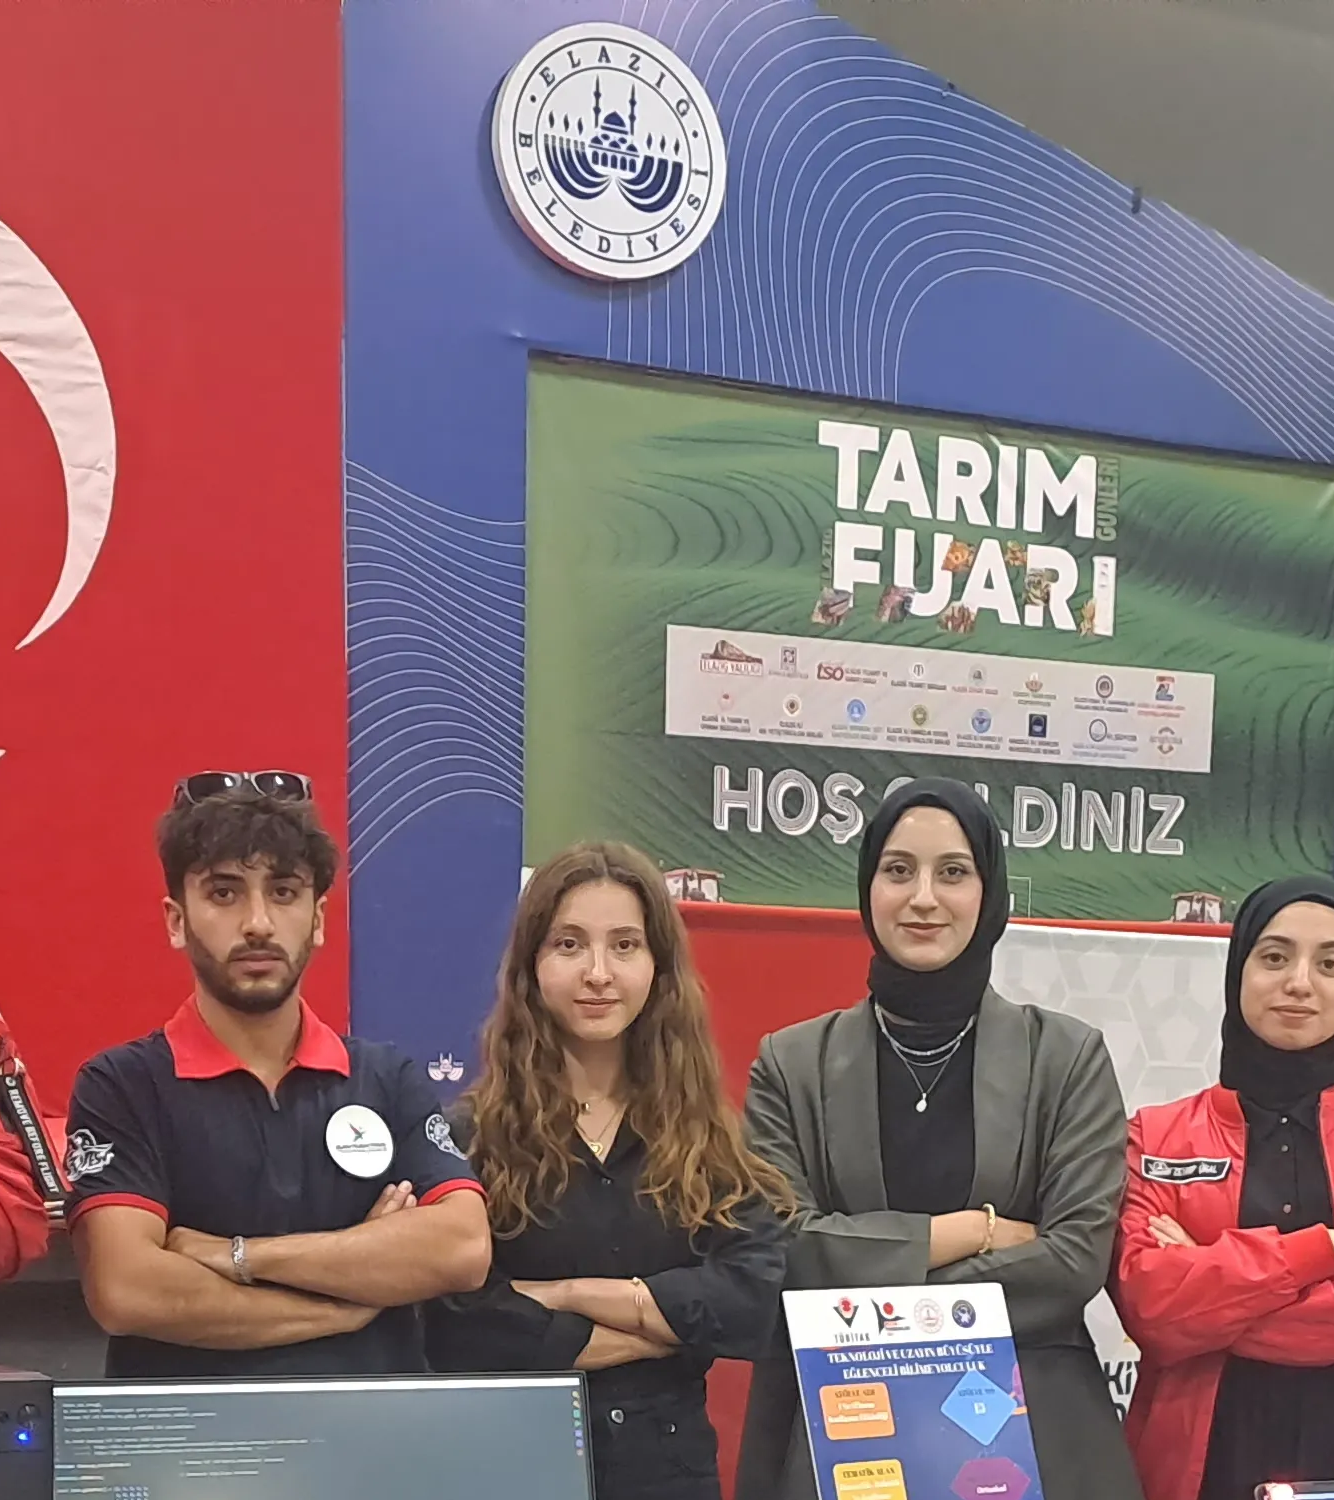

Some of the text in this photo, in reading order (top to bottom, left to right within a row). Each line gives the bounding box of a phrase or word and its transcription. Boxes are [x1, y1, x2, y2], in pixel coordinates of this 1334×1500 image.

[818, 419, 1098, 539] TARIM
[827, 520, 1117, 637] FUARI
[713, 765, 865, 844] HOŞ
[8, 1088, 32, 1126] REMOVE
